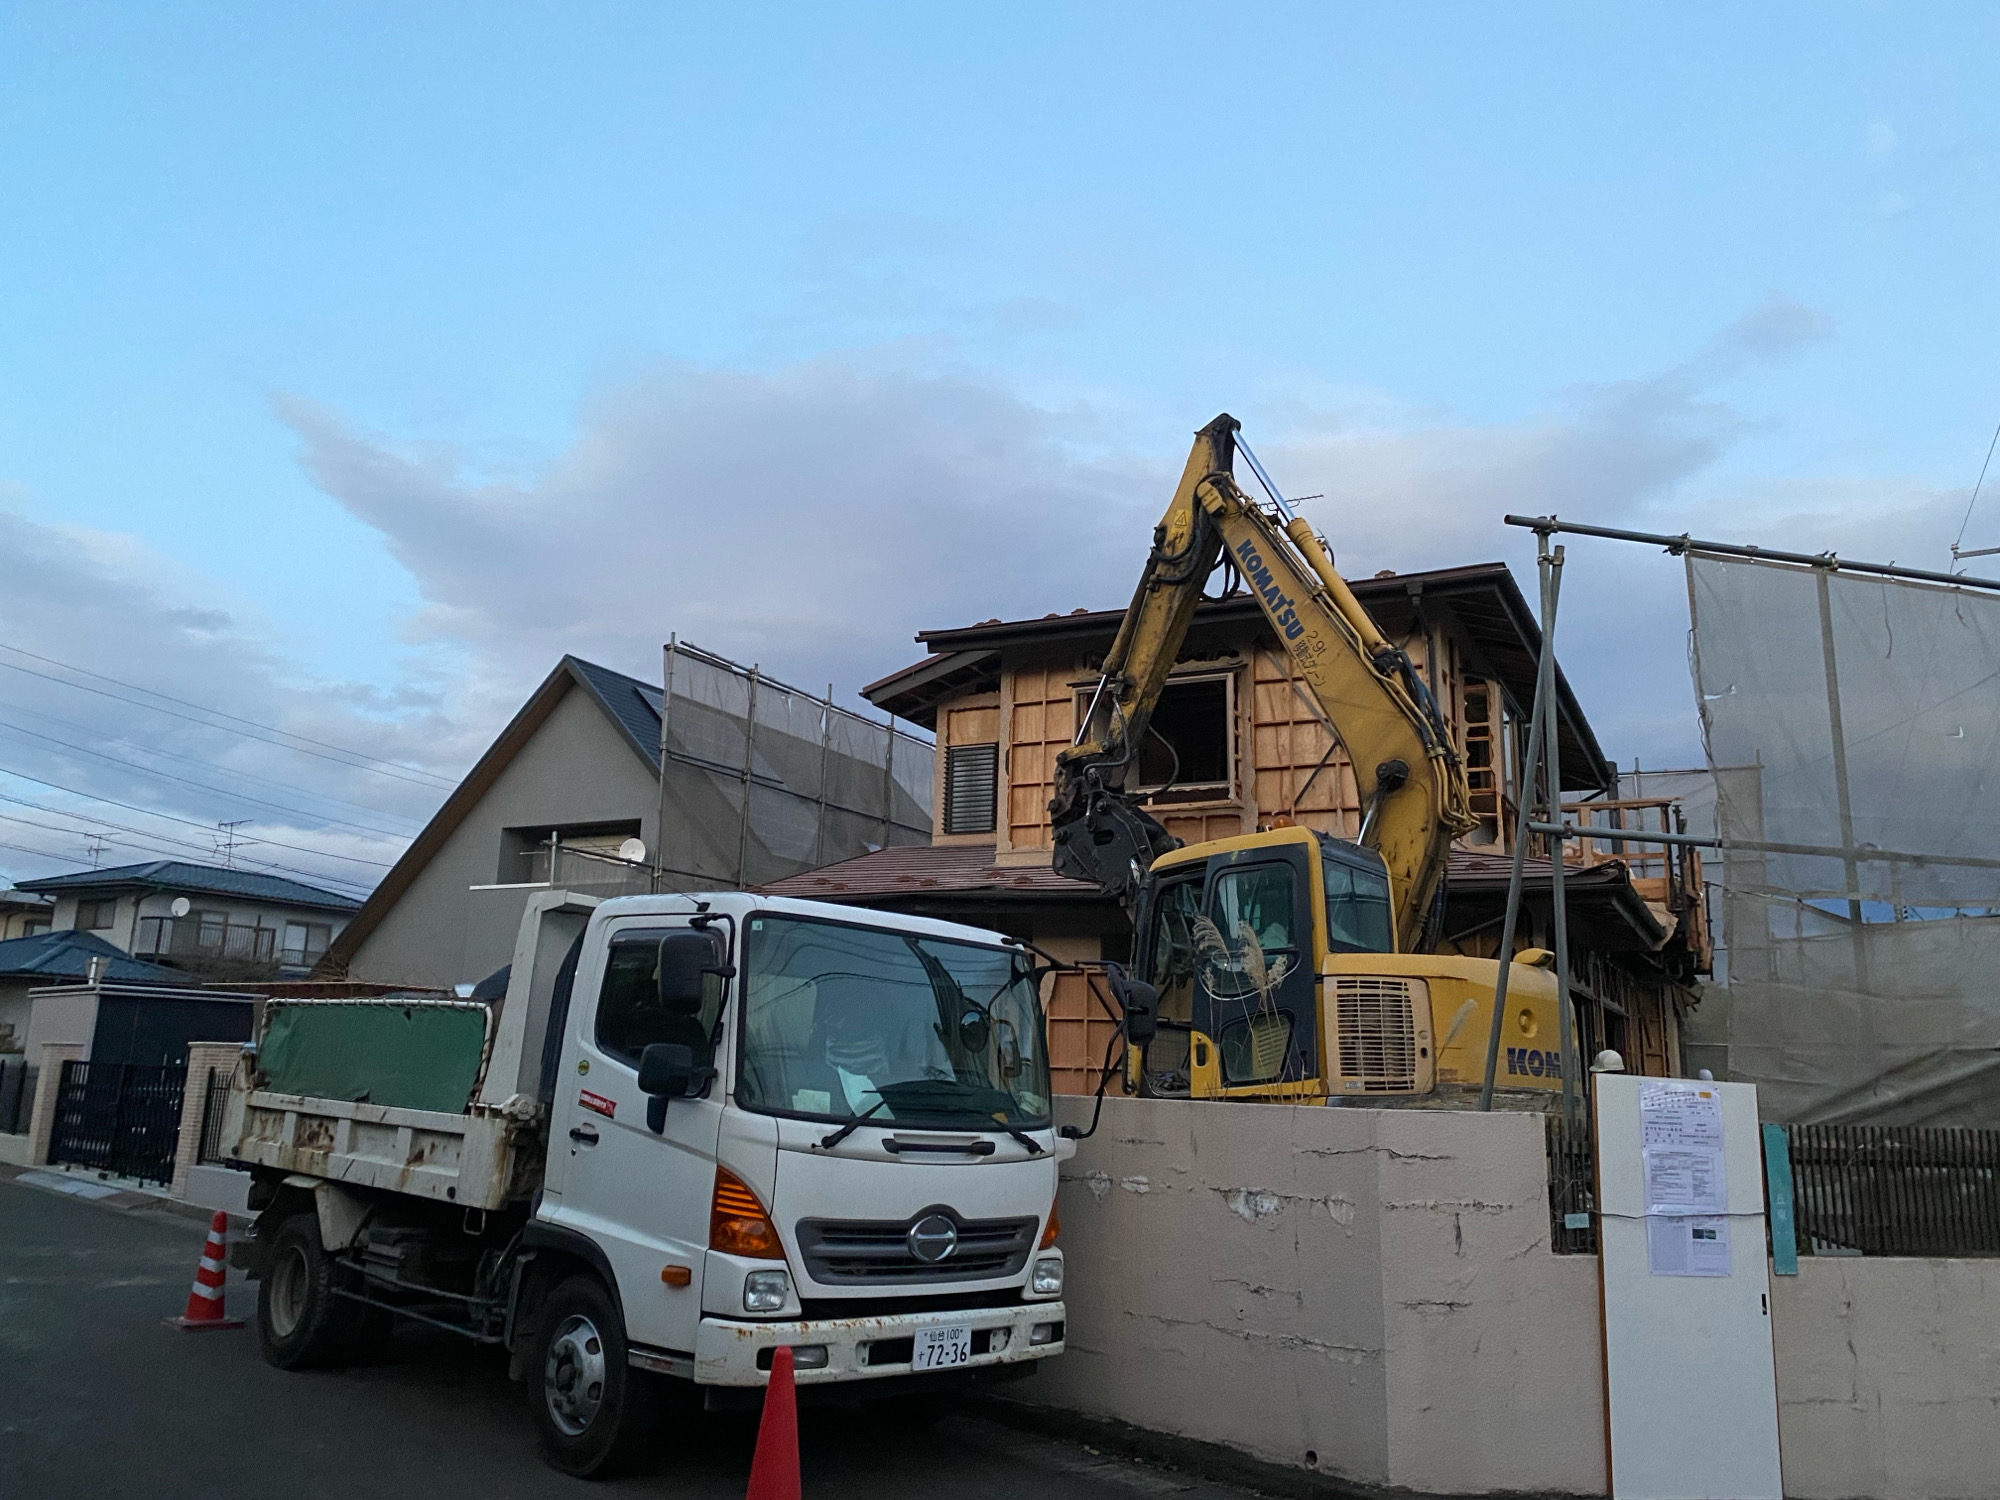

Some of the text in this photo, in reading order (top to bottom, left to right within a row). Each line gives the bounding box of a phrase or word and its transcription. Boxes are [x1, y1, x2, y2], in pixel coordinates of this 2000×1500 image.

[1236, 539, 1305, 640] KOMATSU
[1507, 1047, 1564, 1080] KOM
[927, 1341, 968, 1367] 72-36
